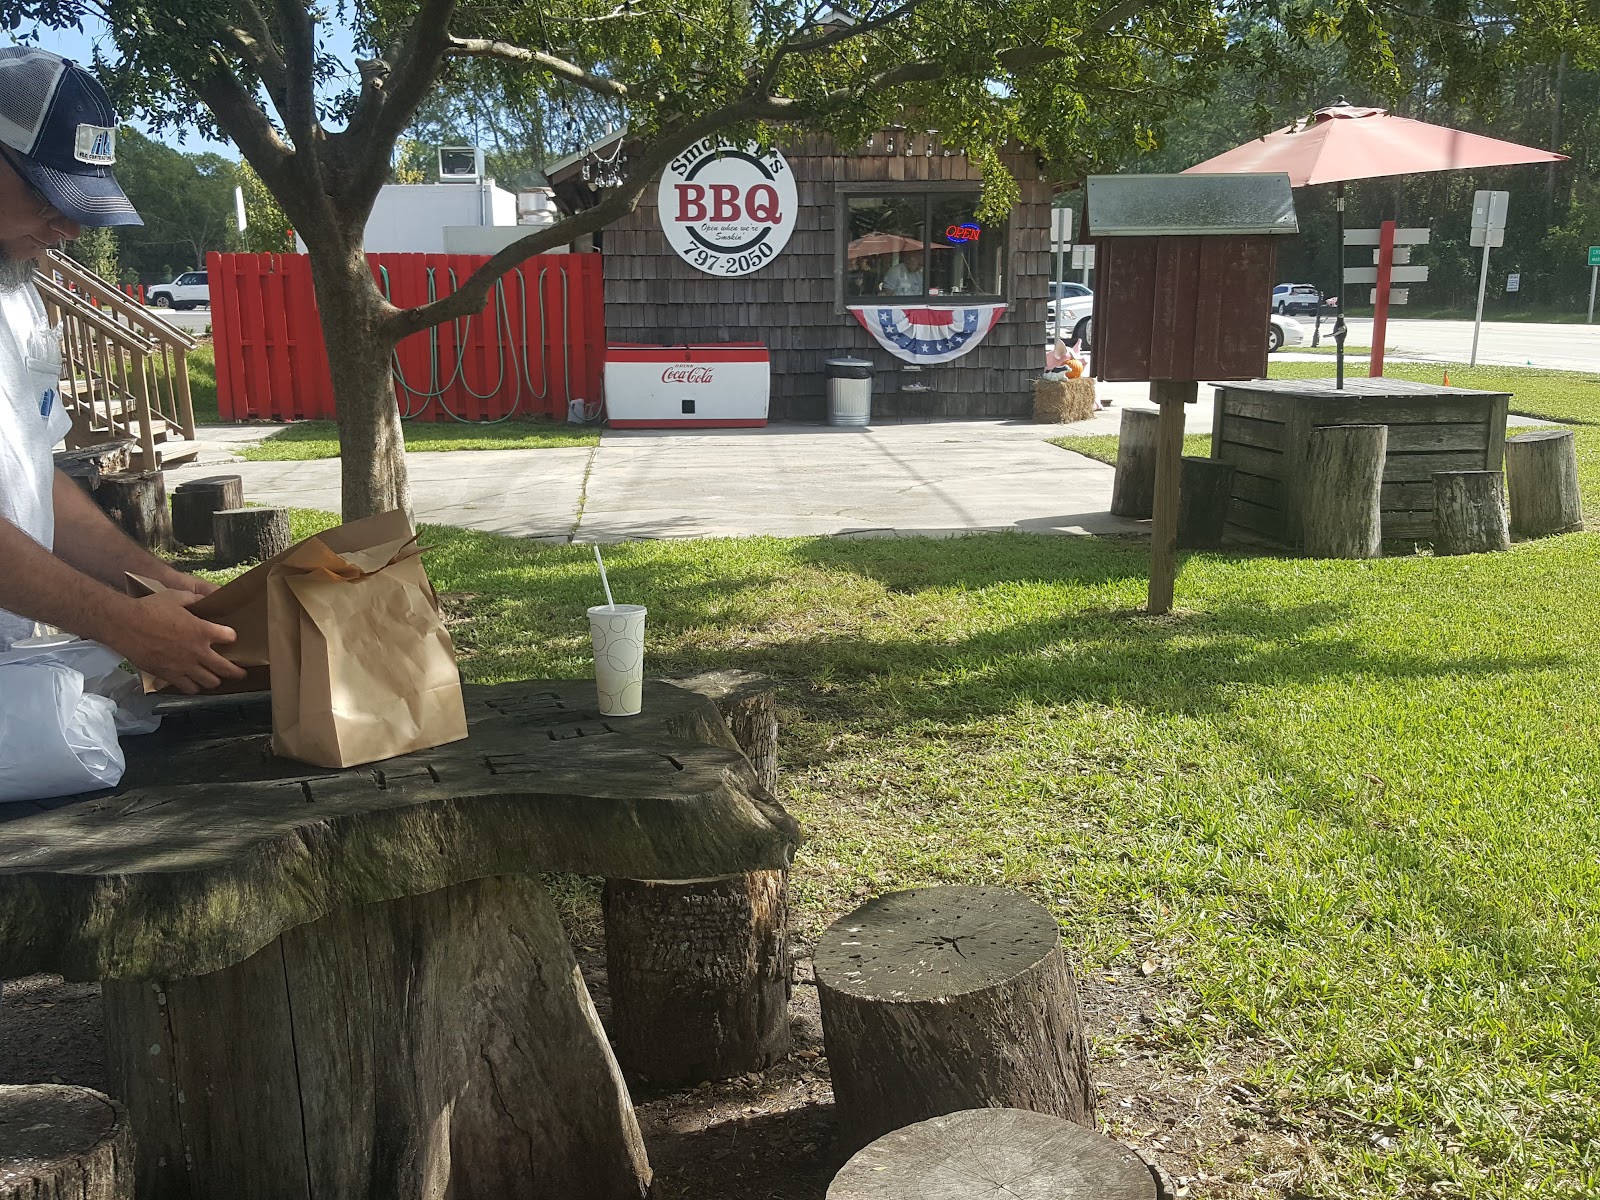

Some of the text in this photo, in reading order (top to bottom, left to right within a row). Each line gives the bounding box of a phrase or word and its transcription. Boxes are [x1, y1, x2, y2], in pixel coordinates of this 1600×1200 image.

[674, 183, 783, 225] BBQ
[701, 223, 759, 233] Open when we're
[715, 232, 745, 241] Smokin'
[945, 225, 981, 241] OPEN
[683, 240, 774, 274] 797-2050
[661, 366, 715, 384] Coca-Cola
